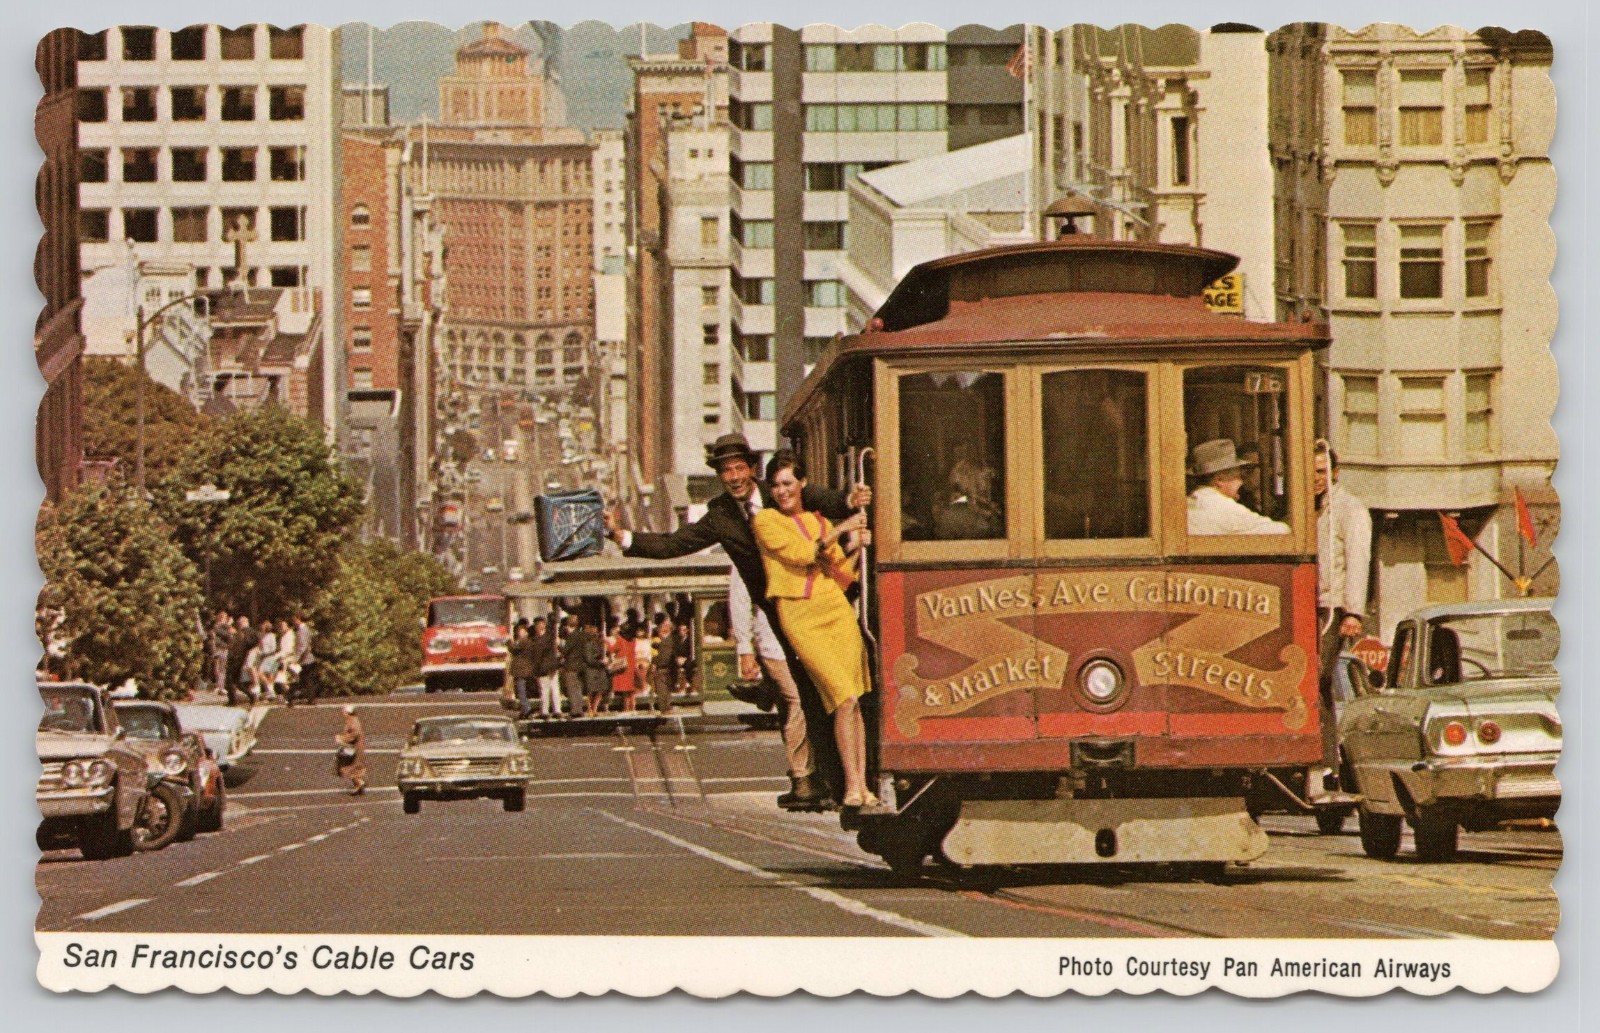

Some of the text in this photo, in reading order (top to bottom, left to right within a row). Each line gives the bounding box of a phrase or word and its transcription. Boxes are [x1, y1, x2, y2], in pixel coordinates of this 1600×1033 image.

[1128, 576, 1270, 615] California
[924, 651, 1275, 707] & Market Streets
